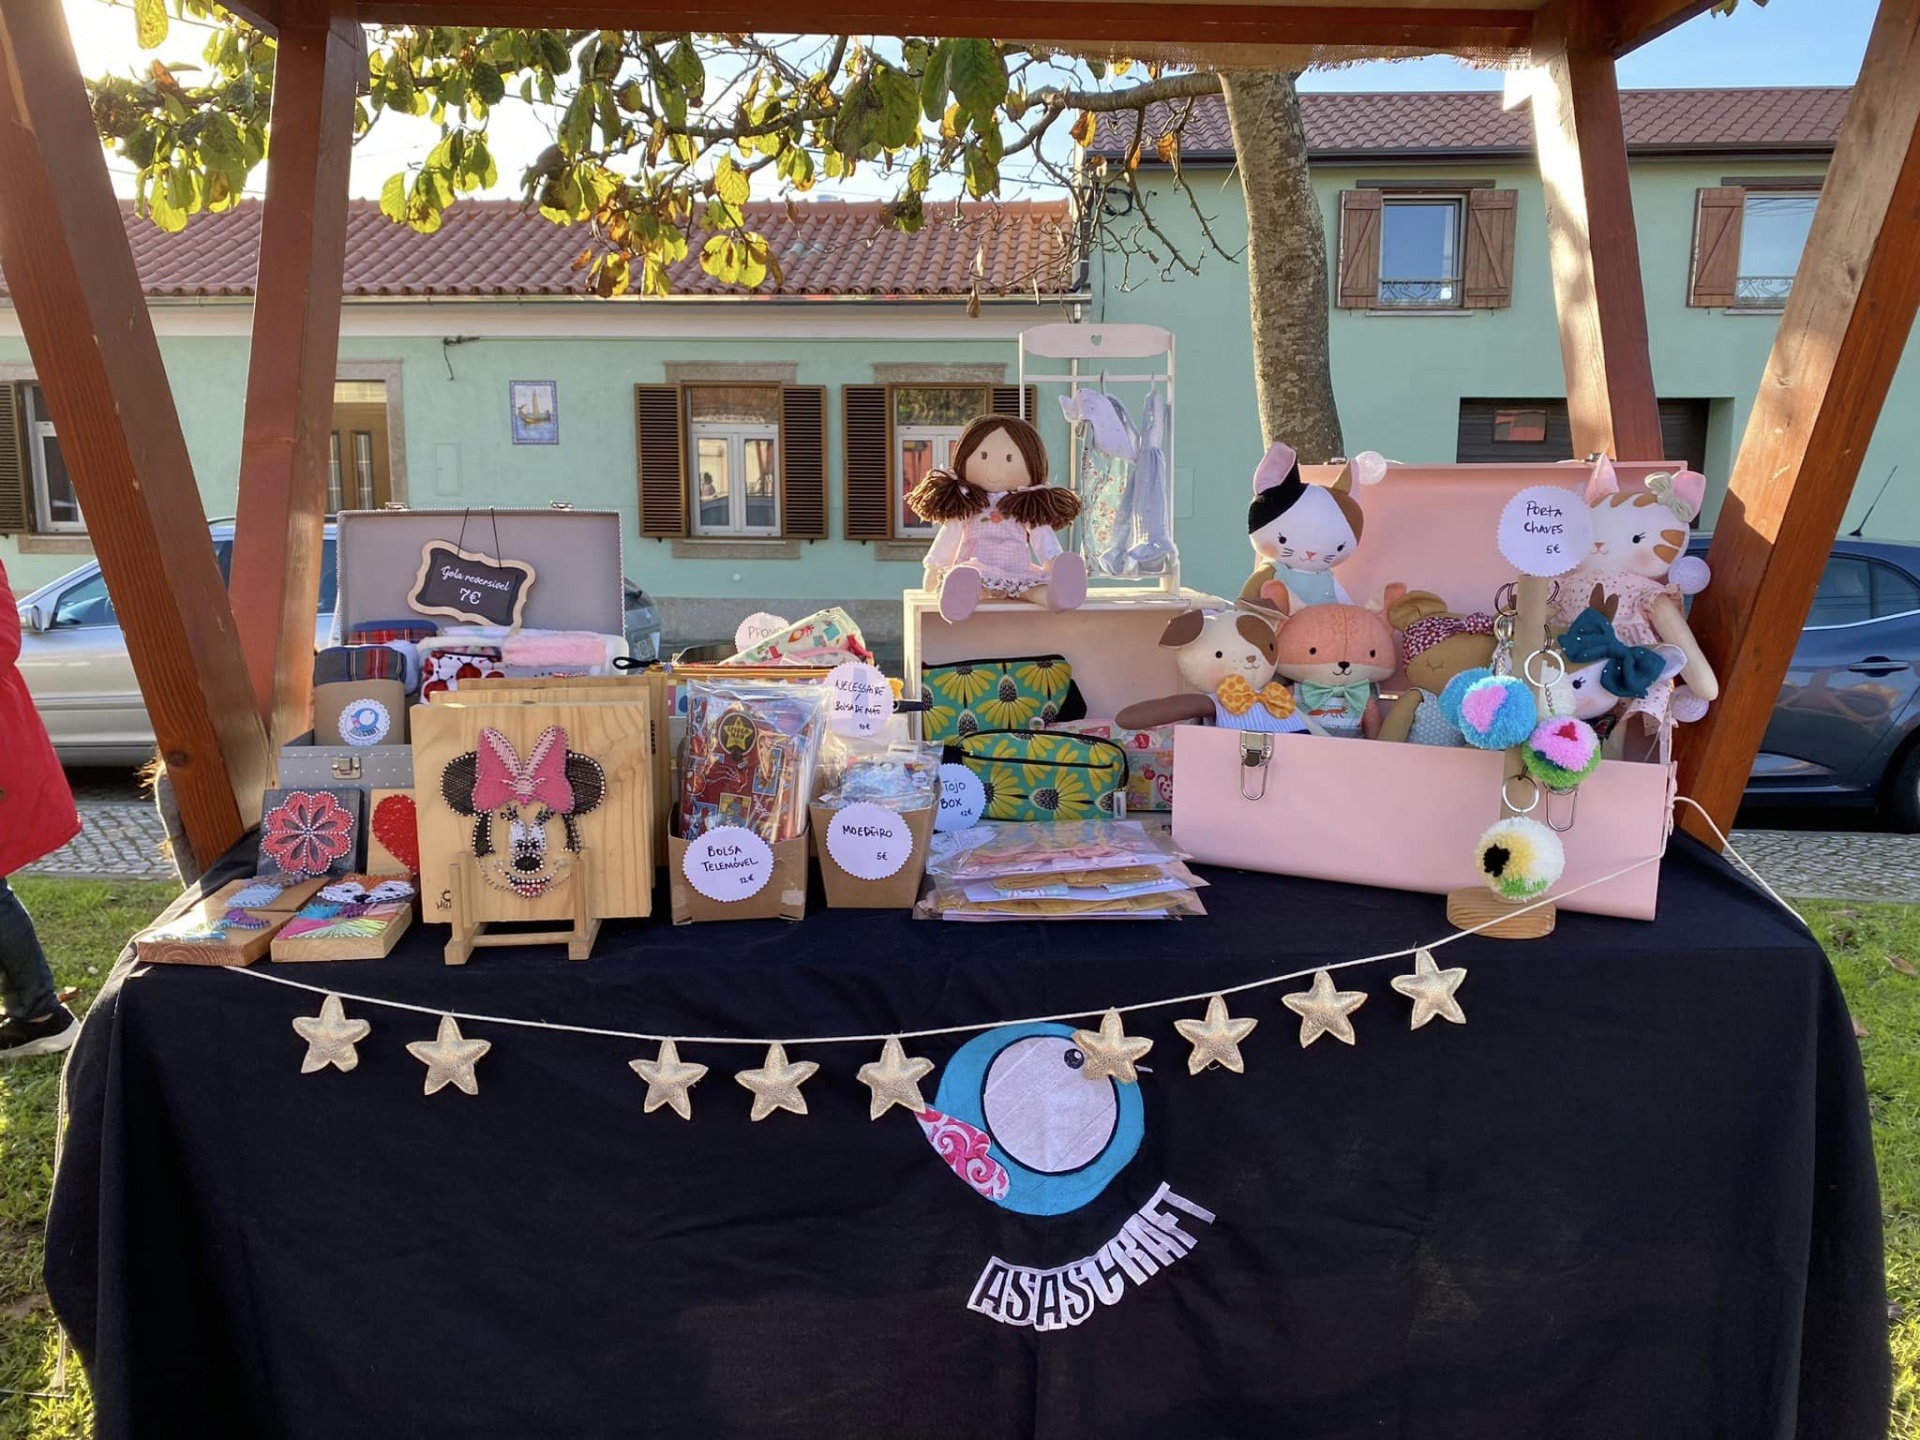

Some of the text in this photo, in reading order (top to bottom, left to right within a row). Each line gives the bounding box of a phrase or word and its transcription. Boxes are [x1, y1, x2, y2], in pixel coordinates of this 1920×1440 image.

[1545, 543, 1561, 555] 5€
[440, 564, 464, 581] Gola
[459, 587, 482, 605] 7€
[940, 797, 962, 810] BOX
[707, 844, 742, 857] BOLSA
[876, 851, 888, 861] 5€
[966, 1180, 1217, 1332] ASASCRAFT
